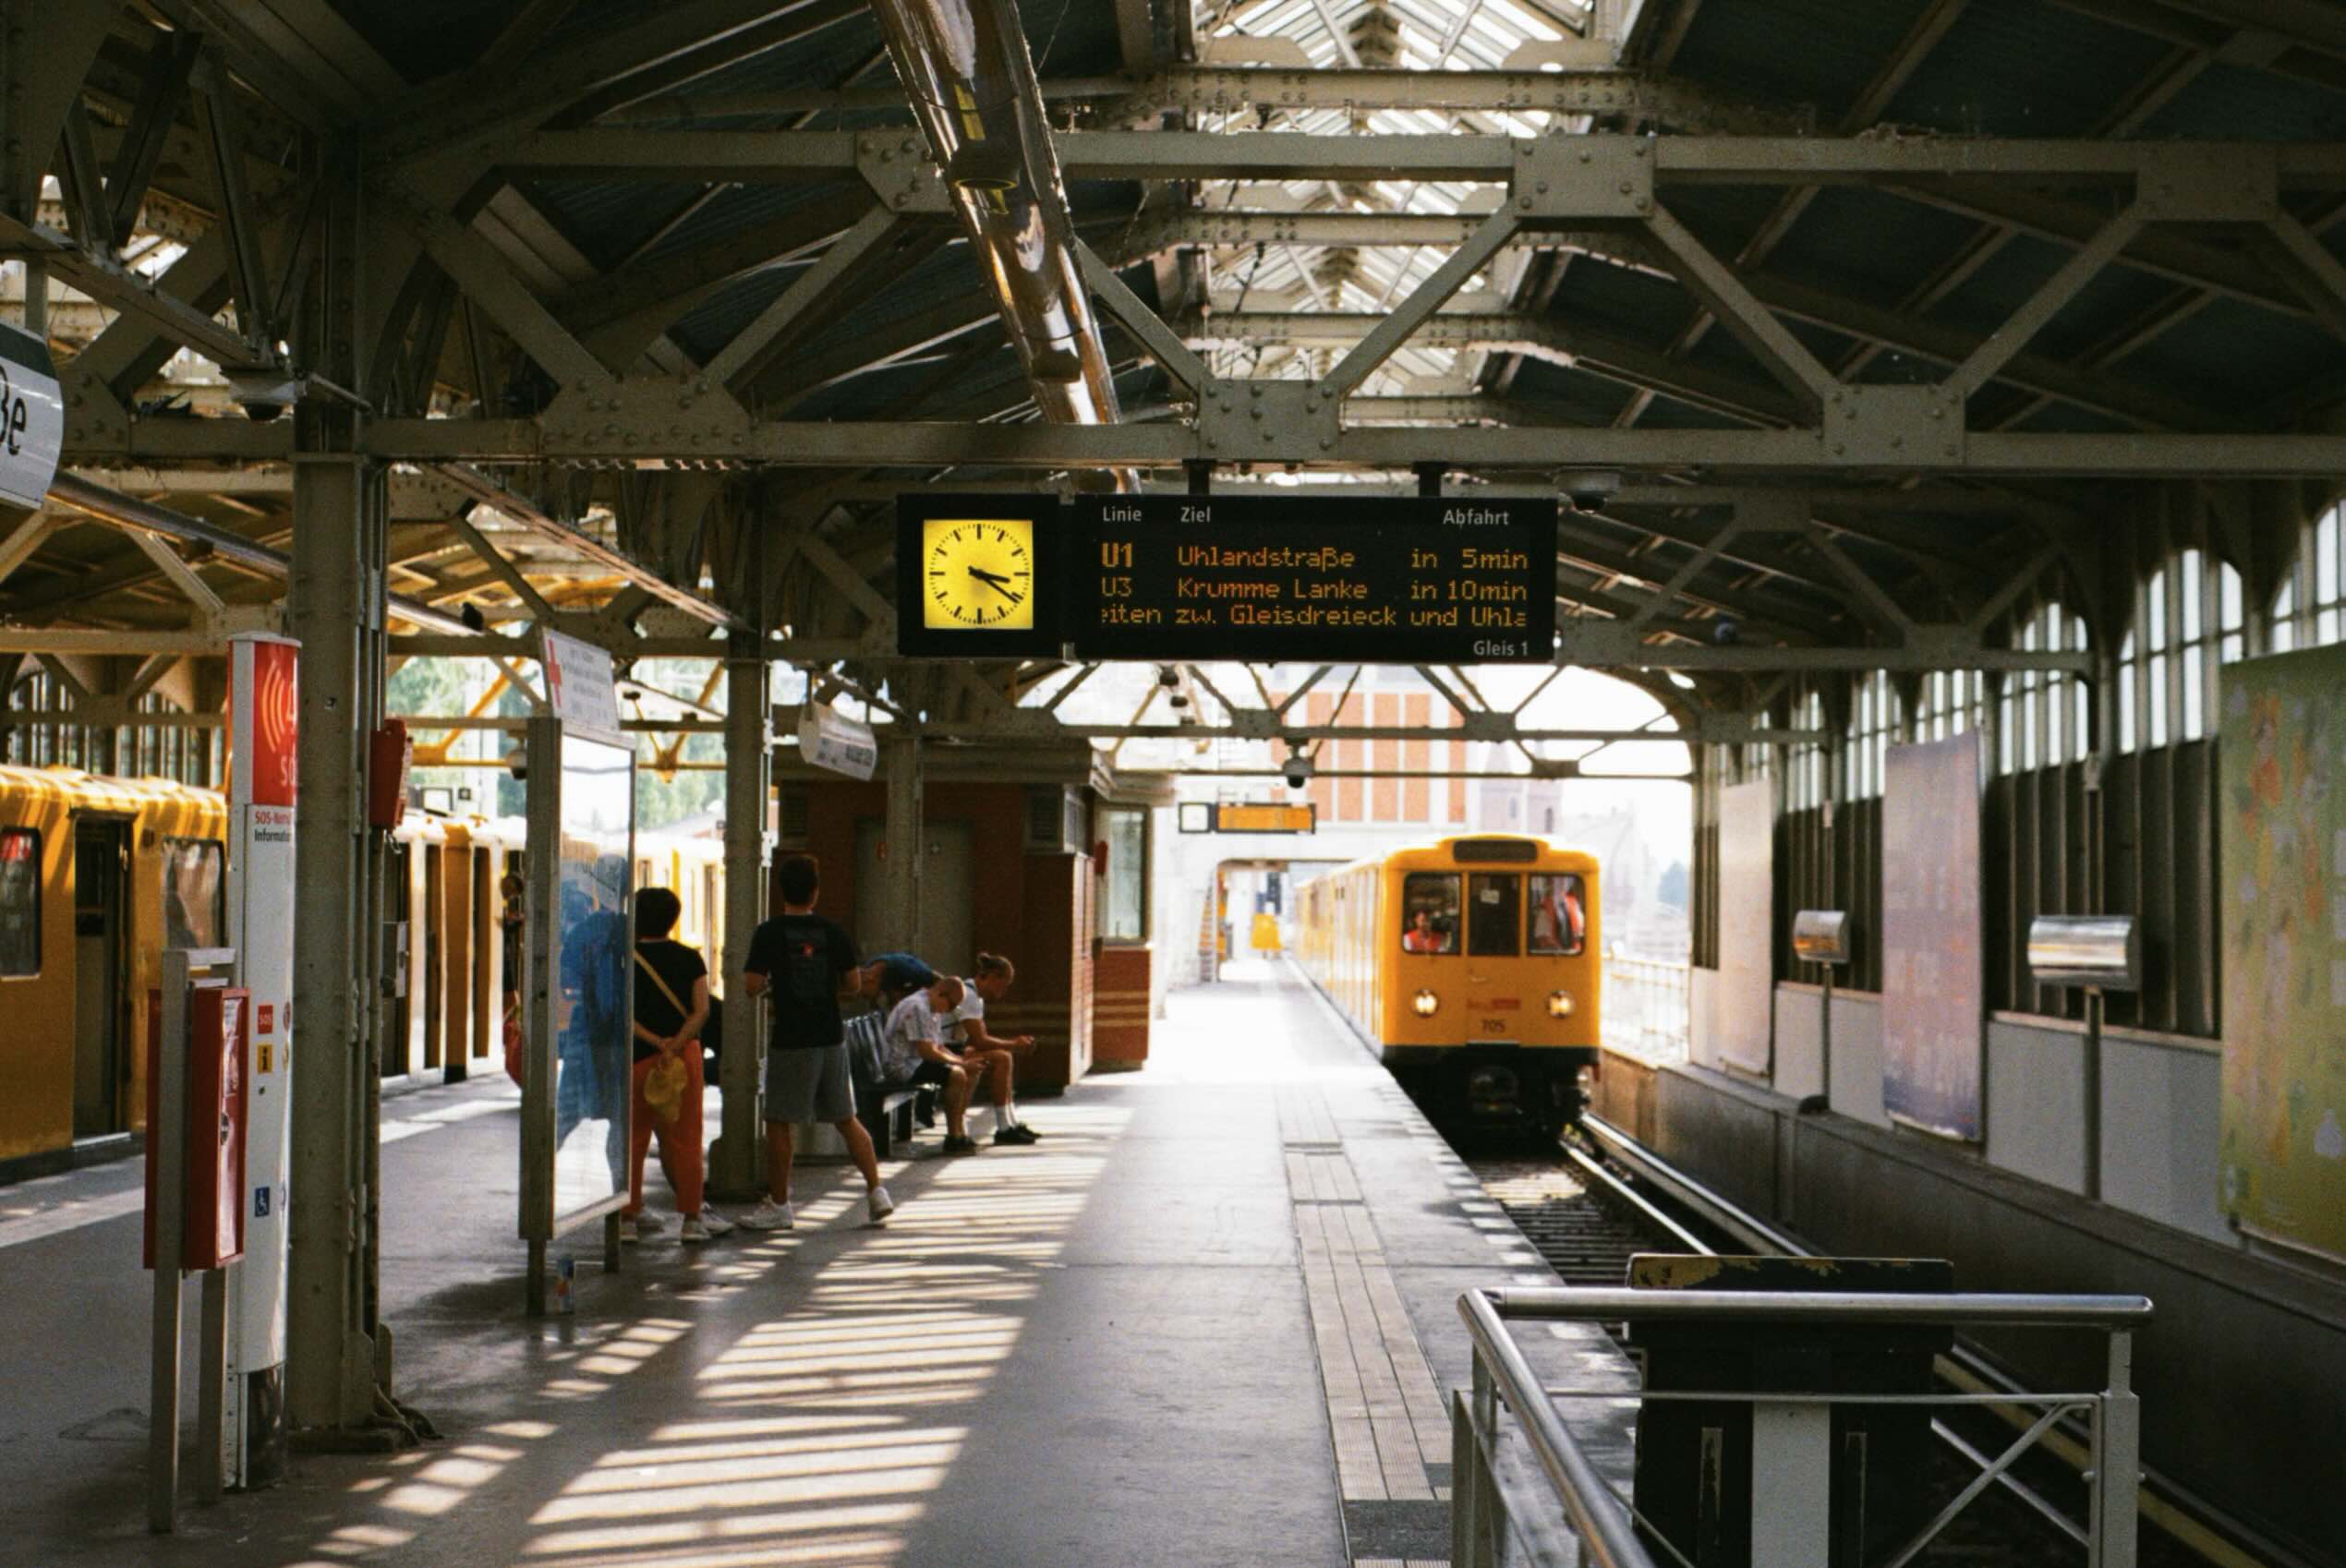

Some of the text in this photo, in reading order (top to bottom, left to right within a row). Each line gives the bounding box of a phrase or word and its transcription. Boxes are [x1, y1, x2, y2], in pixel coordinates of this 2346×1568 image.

[1102, 506, 1211, 523] Linie Ziel
[1443, 509, 1508, 525] Abfahrt
[1102, 542, 1528, 572] U1 Uhlandstraße in 5min
[1102, 576, 1527, 601] U3 Krumme Lanke in 10min
[1176, 609, 1216, 624] zw.
[1230, 604, 1396, 625] Gleisdreieck
[1410, 606, 1457, 626] und
[1473, 640, 1528, 656] Gleis 1
